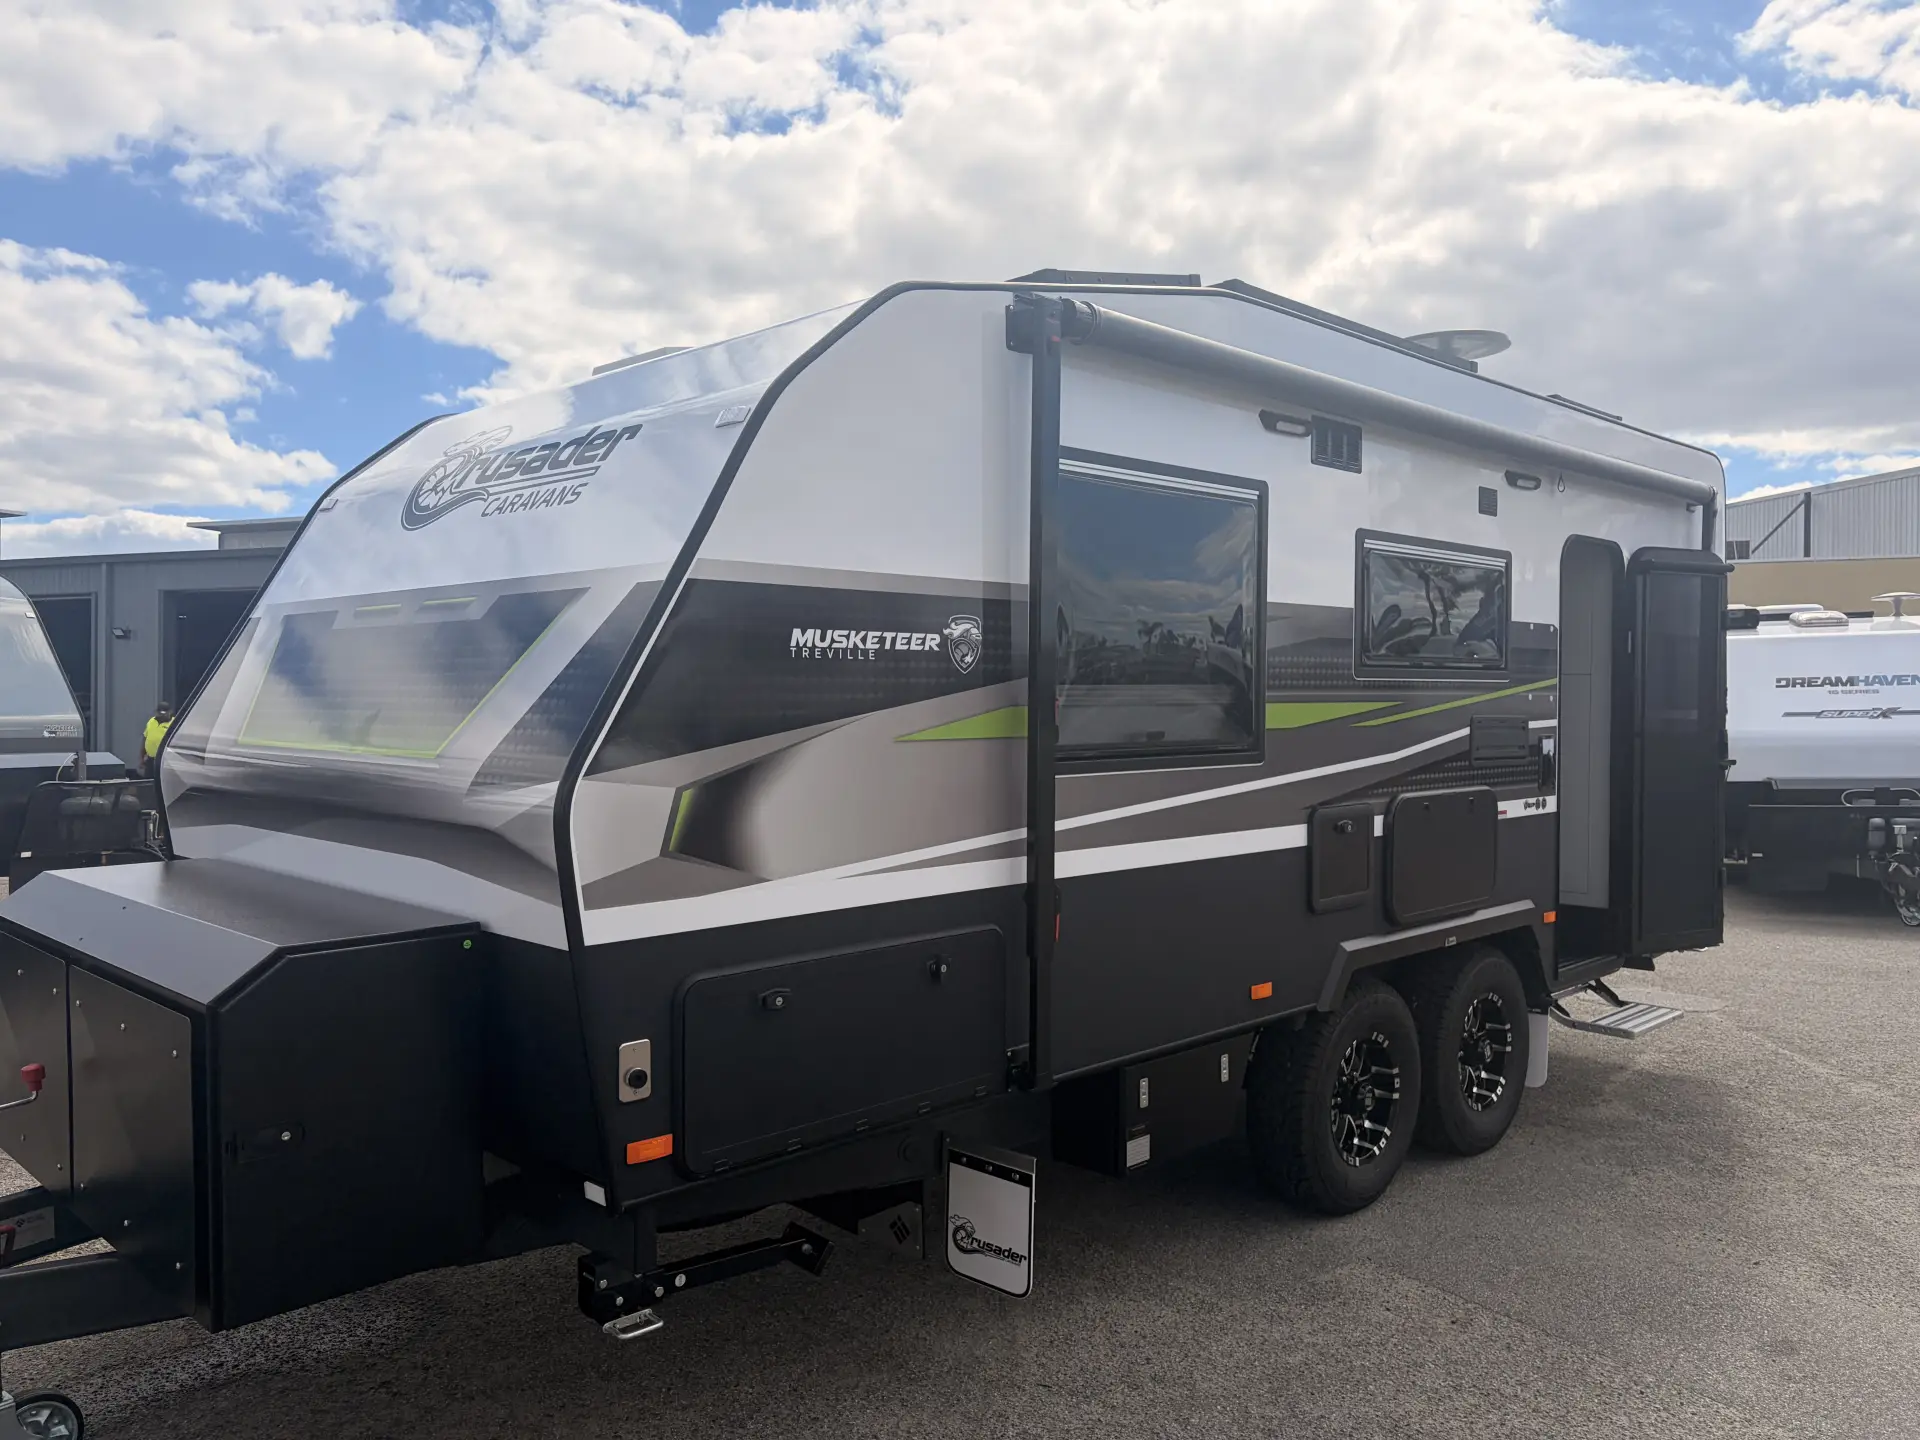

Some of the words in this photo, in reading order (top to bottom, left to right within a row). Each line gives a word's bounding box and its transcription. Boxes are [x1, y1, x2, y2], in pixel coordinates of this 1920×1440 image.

[481, 482, 589, 517] CARAVANS
[790, 628, 940, 650] MUSKETEER
[790, 648, 876, 659] TREVILLE
